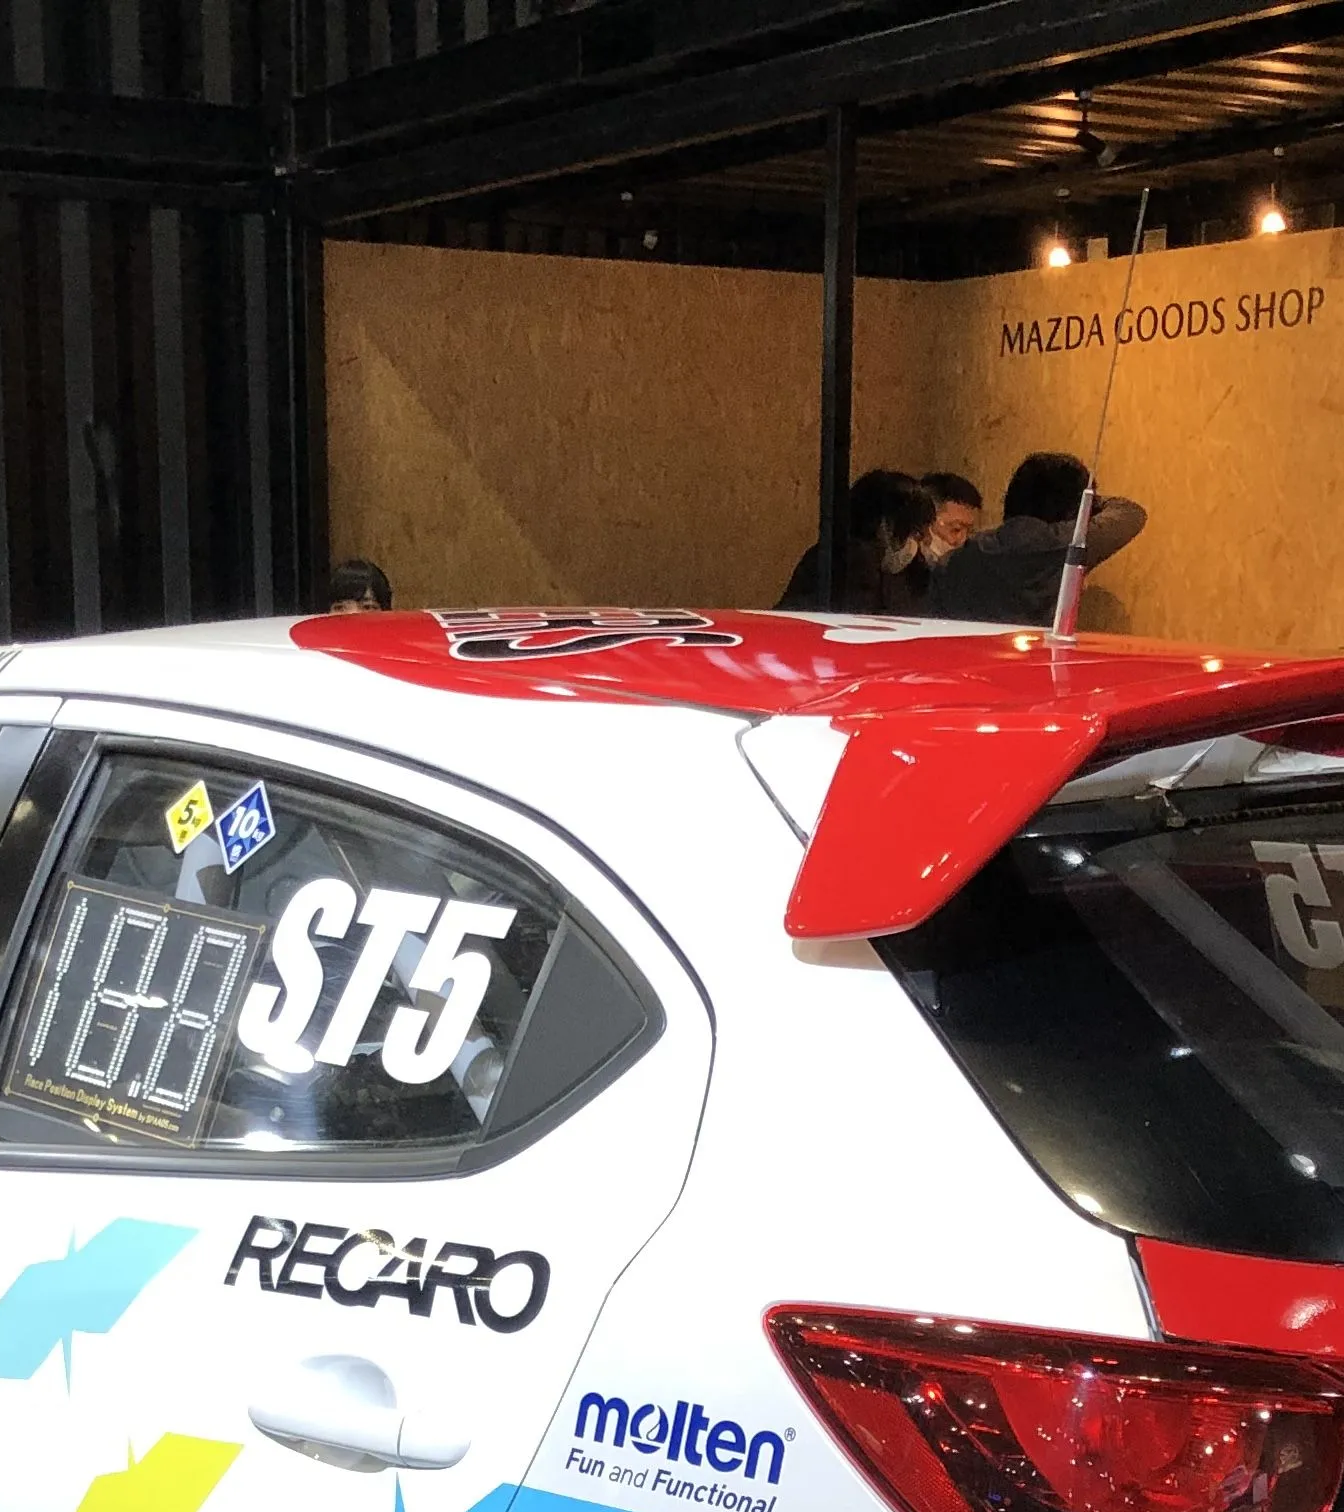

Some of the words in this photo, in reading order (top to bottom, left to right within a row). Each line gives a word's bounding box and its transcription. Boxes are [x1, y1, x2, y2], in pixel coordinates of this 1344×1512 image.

[999, 312, 1105, 357] MAZDA
[1115, 297, 1227, 345] GOODS
[1235, 286, 1325, 332] SHOP
[237, 878, 517, 1086] ST5
[24, 1073, 44, 1091] Race
[43, 1077, 77, 1102] Position
[76, 1088, 107, 1112] Display
[106, 1097, 139, 1120] System
[223, 1214, 550, 1335] RECARO
[565, 1447, 606, 1479] Fun
[608, 1464, 649, 1490] and
